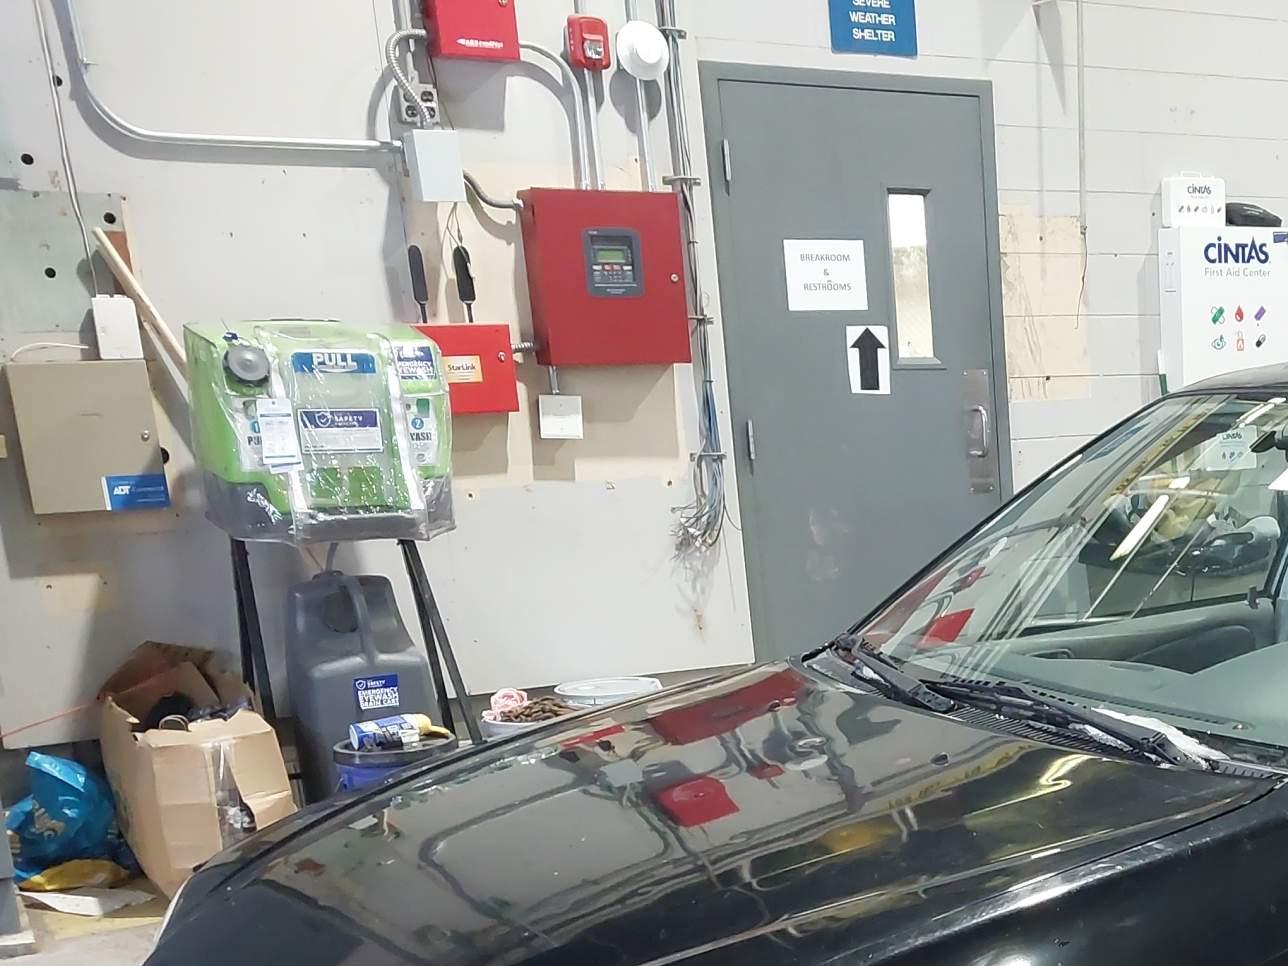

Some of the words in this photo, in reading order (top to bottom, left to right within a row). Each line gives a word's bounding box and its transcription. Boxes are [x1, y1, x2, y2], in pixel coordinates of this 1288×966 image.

[852, 0, 890, 8] SEVERE
[849, 11, 896, 25] WEATHER
[852, 28, 895, 41] SHELTER
[1204, 235, 1271, 264] CiNTAS
[800, 253, 850, 262] BREAKROOM
[1205, 267, 1223, 277] First
[1226, 267, 1240, 277] Aid
[1243, 267, 1272, 277] Center
[803, 282, 852, 292] RESTROOMS
[312, 352, 357, 366] PULL
[447, 363, 476, 371] StarLink
[415, 419, 422, 429] 2
[113, 485, 130, 495] ADT
[358, 687, 398, 696] EMERGENCY
[359, 692, 399, 702] EYEWASH
